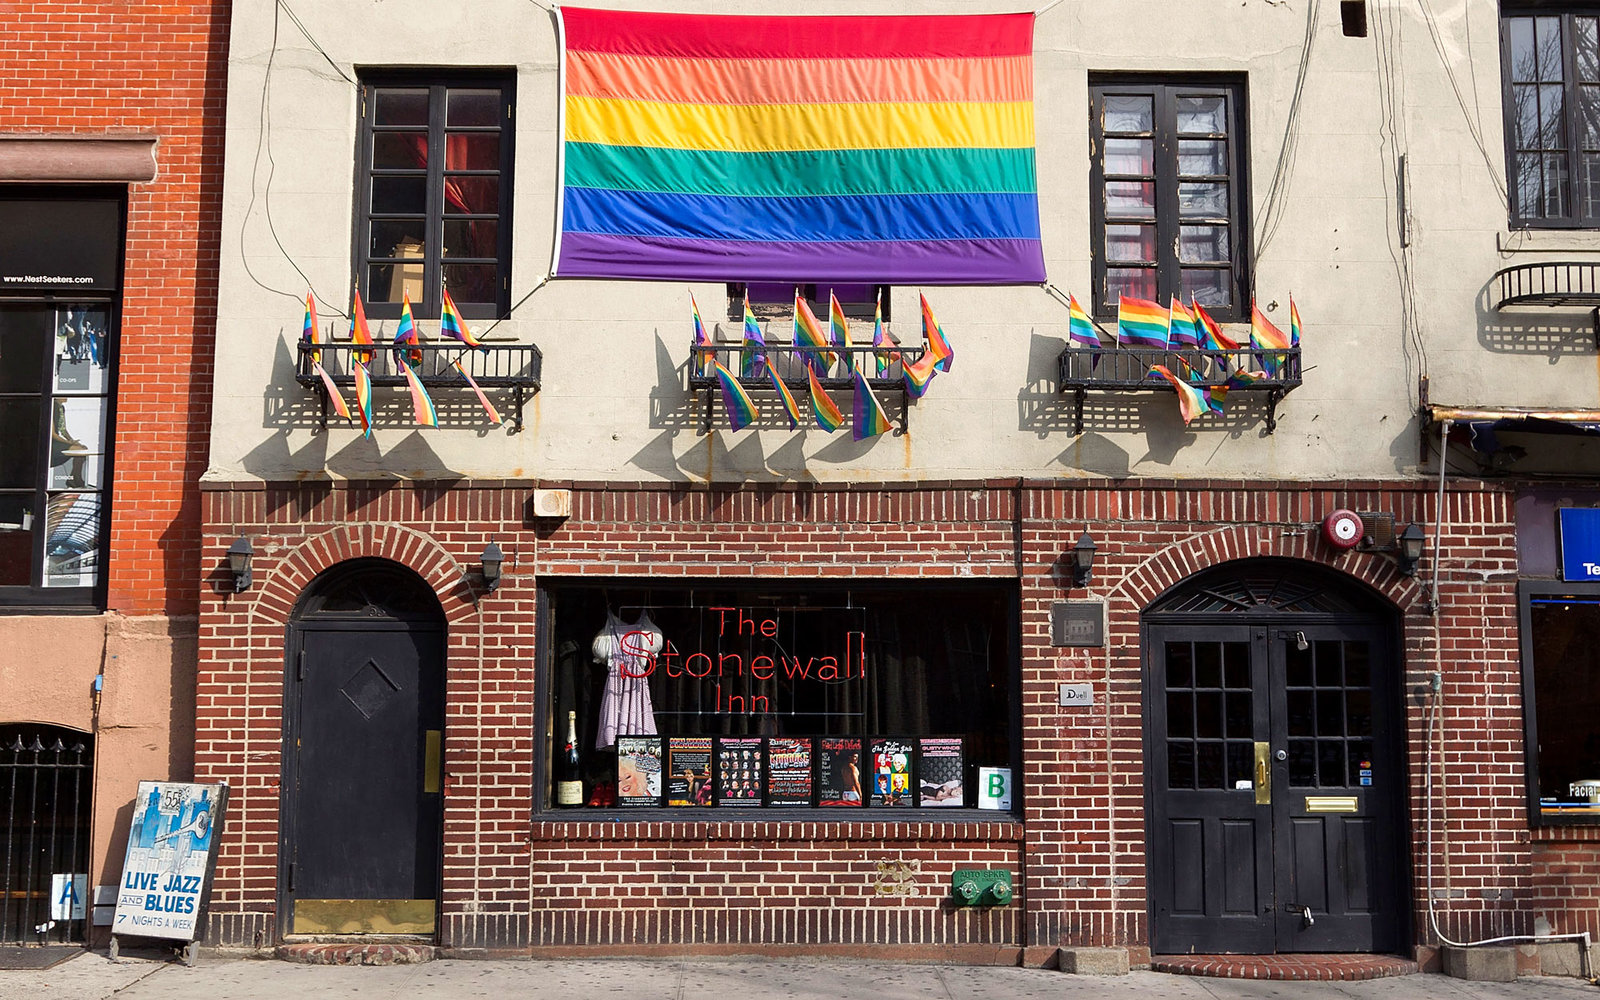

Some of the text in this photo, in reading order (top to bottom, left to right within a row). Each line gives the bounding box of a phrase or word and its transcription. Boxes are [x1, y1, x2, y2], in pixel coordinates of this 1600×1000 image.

[3, 275, 94, 284] www.NestSeekers.com
[708, 607, 778, 637] The
[620, 630, 865, 680] Stonewall
[716, 684, 769, 713] Inn
[871, 745, 883, 753] The
[882, 744, 900, 754] Golden
[988, 773, 1005, 798] B
[1569, 782, 1597, 797] Facial
[125, 871, 201, 894] LIVE JAZZ
[961, 870, 1005, 878] AUTO SPKR
[58, 881, 80, 904] A
[121, 894, 195, 914] AND BLUES
[117, 914, 192, 930] 7 NIGHTS A WEEK
